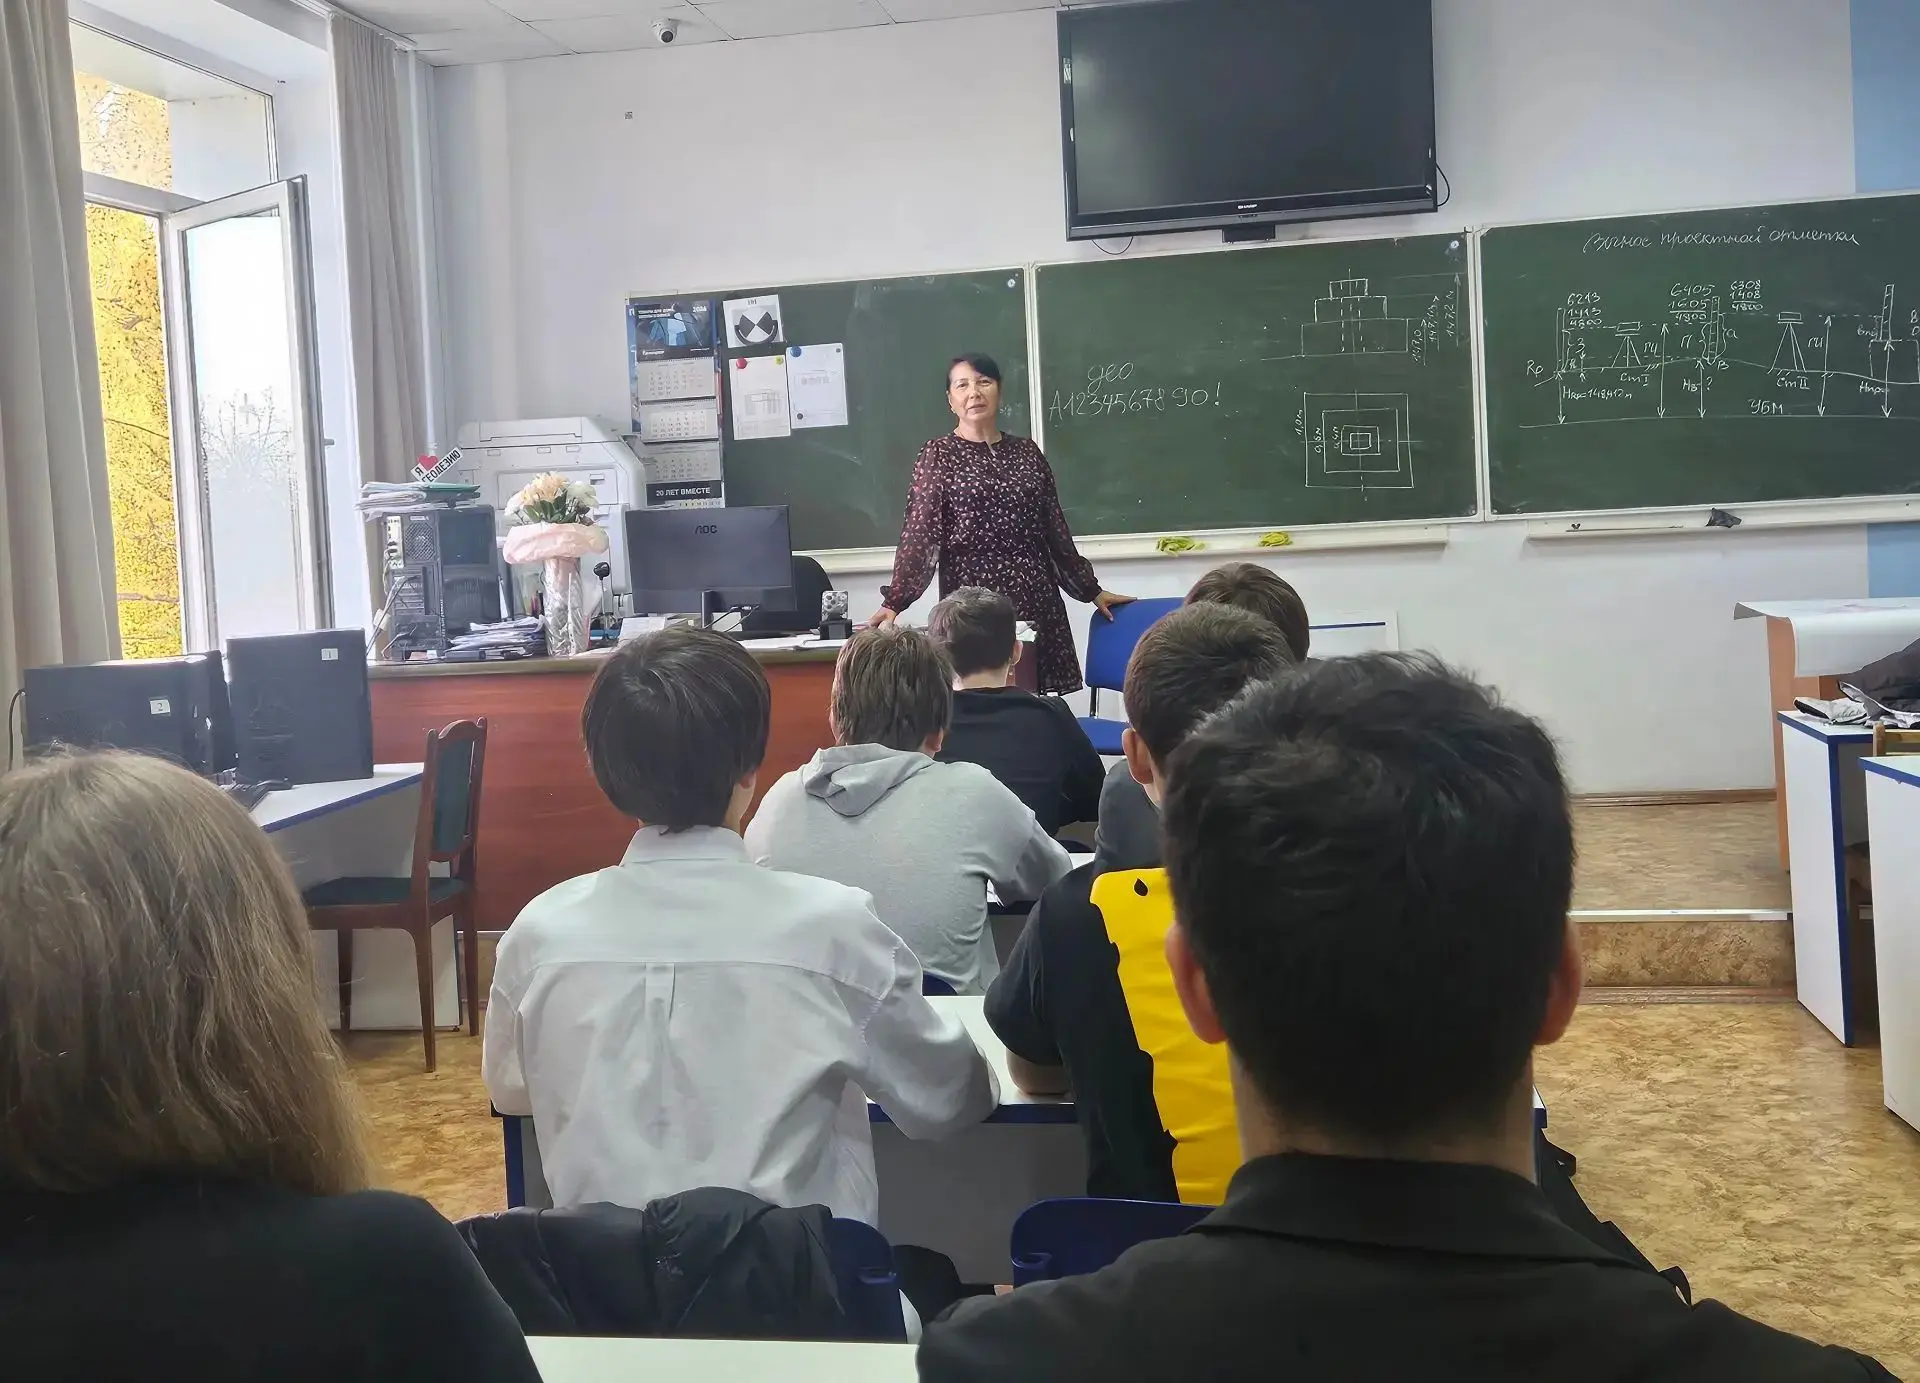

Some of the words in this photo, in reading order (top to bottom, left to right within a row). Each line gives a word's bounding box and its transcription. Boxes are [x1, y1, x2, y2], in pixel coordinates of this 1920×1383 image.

[1661, 226, 1765, 249] проектной
[1769, 229, 1860, 246] отметки
[1670, 283, 1715, 297] 6405
[1567, 292, 1601, 307] 6213
[1747, 398, 1784, 415] УБМ
[414, 466, 424, 477] Я
[421, 449, 461, 483] ГЕОДЕЗИЮ
[665, 488, 680, 496] ЛЕТ
[680, 486, 711, 496] ВМЕСТЕ
